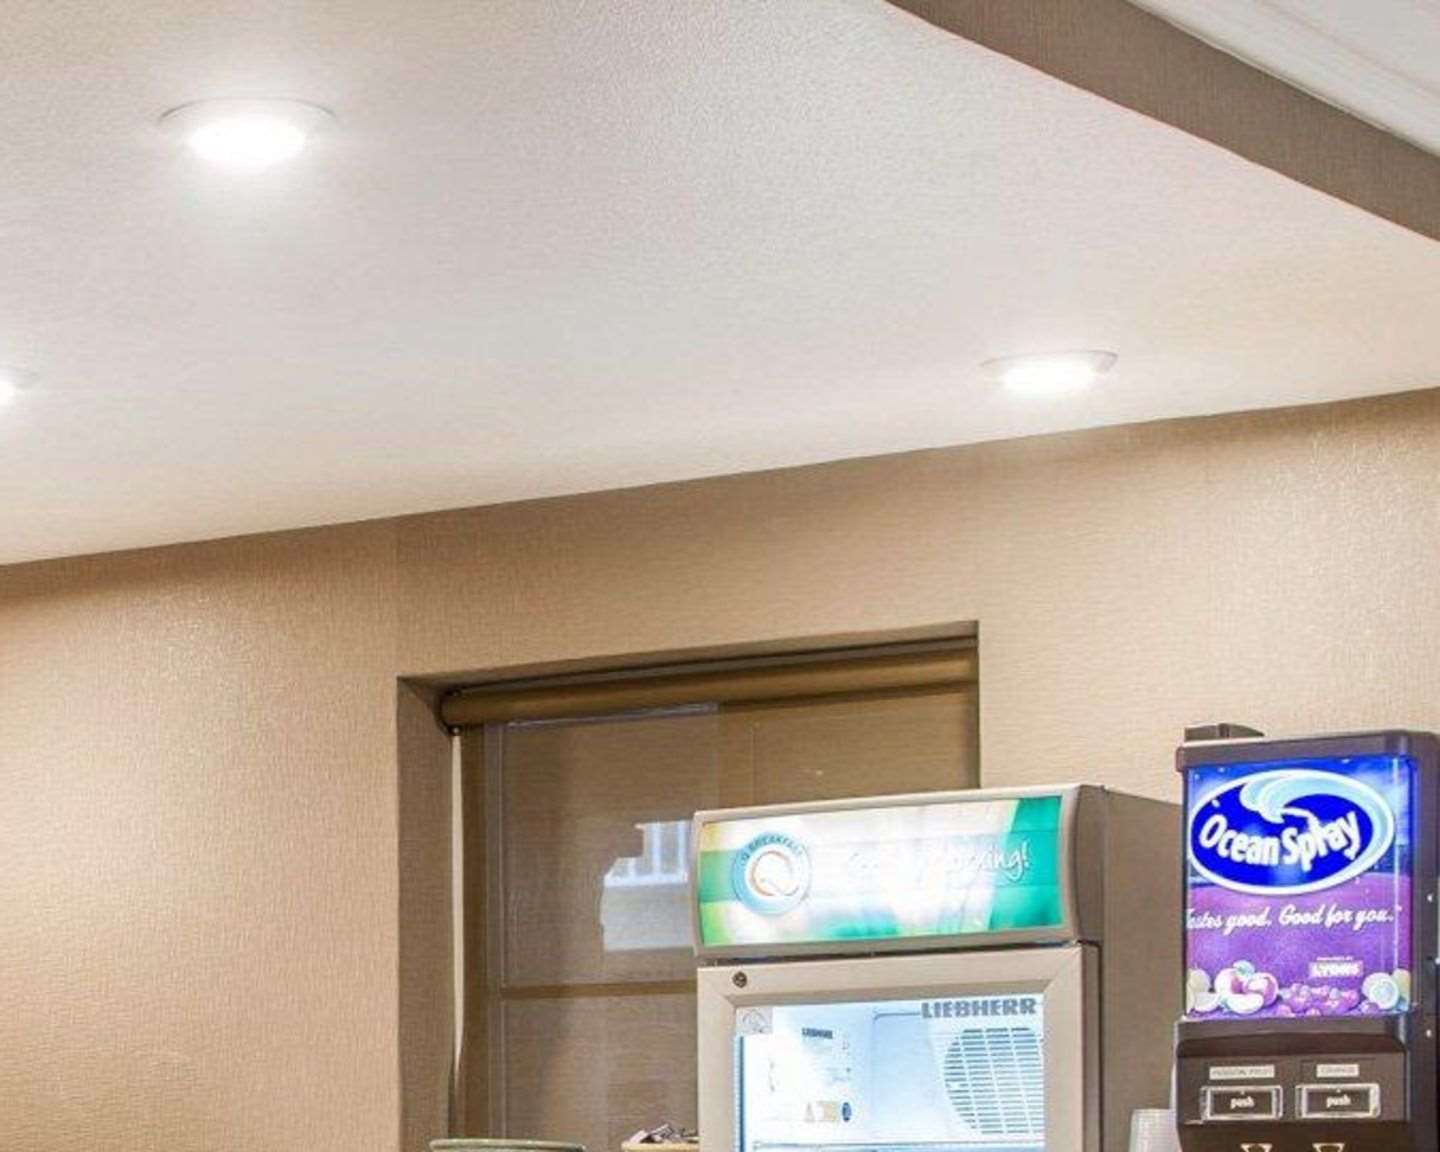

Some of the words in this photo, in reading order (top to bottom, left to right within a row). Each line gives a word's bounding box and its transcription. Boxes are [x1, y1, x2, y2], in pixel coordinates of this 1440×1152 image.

[1198, 813, 1281, 866] Ocean
[1281, 810, 1360, 872] Spray
[1223, 906, 1272, 935] good.
[1278, 904, 1325, 924] Good
[1324, 903, 1353, 928] for
[1353, 908, 1394, 931] you.
[921, 998, 1037, 1018] LIEBHERR
[1230, 1096, 1255, 1110] push
[1326, 1094, 1352, 1108] push
